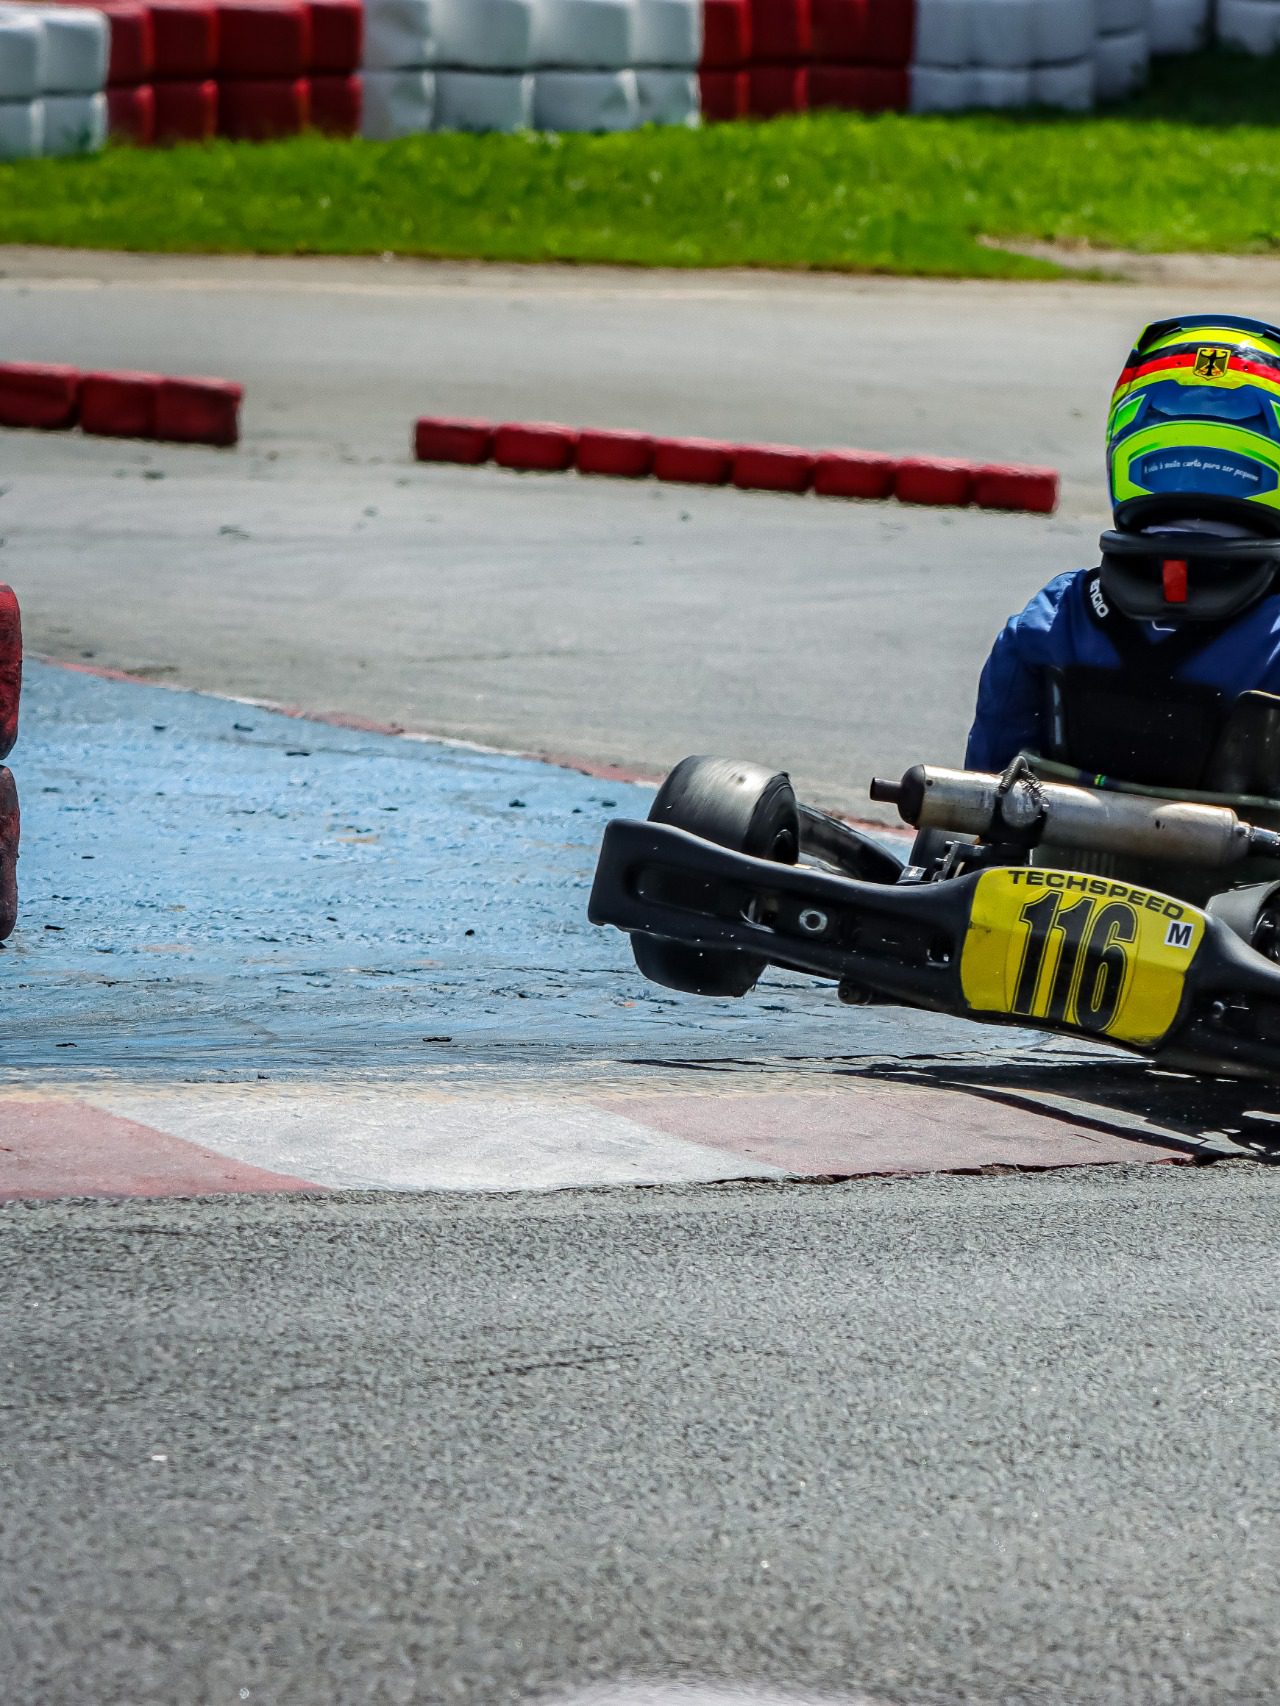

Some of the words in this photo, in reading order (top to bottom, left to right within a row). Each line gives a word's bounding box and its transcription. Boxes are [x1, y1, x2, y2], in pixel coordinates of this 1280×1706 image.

[1008, 870, 1184, 920] TECHSPEED
[1166, 922, 1193, 946] M
[1010, 889, 1138, 1032] 116
